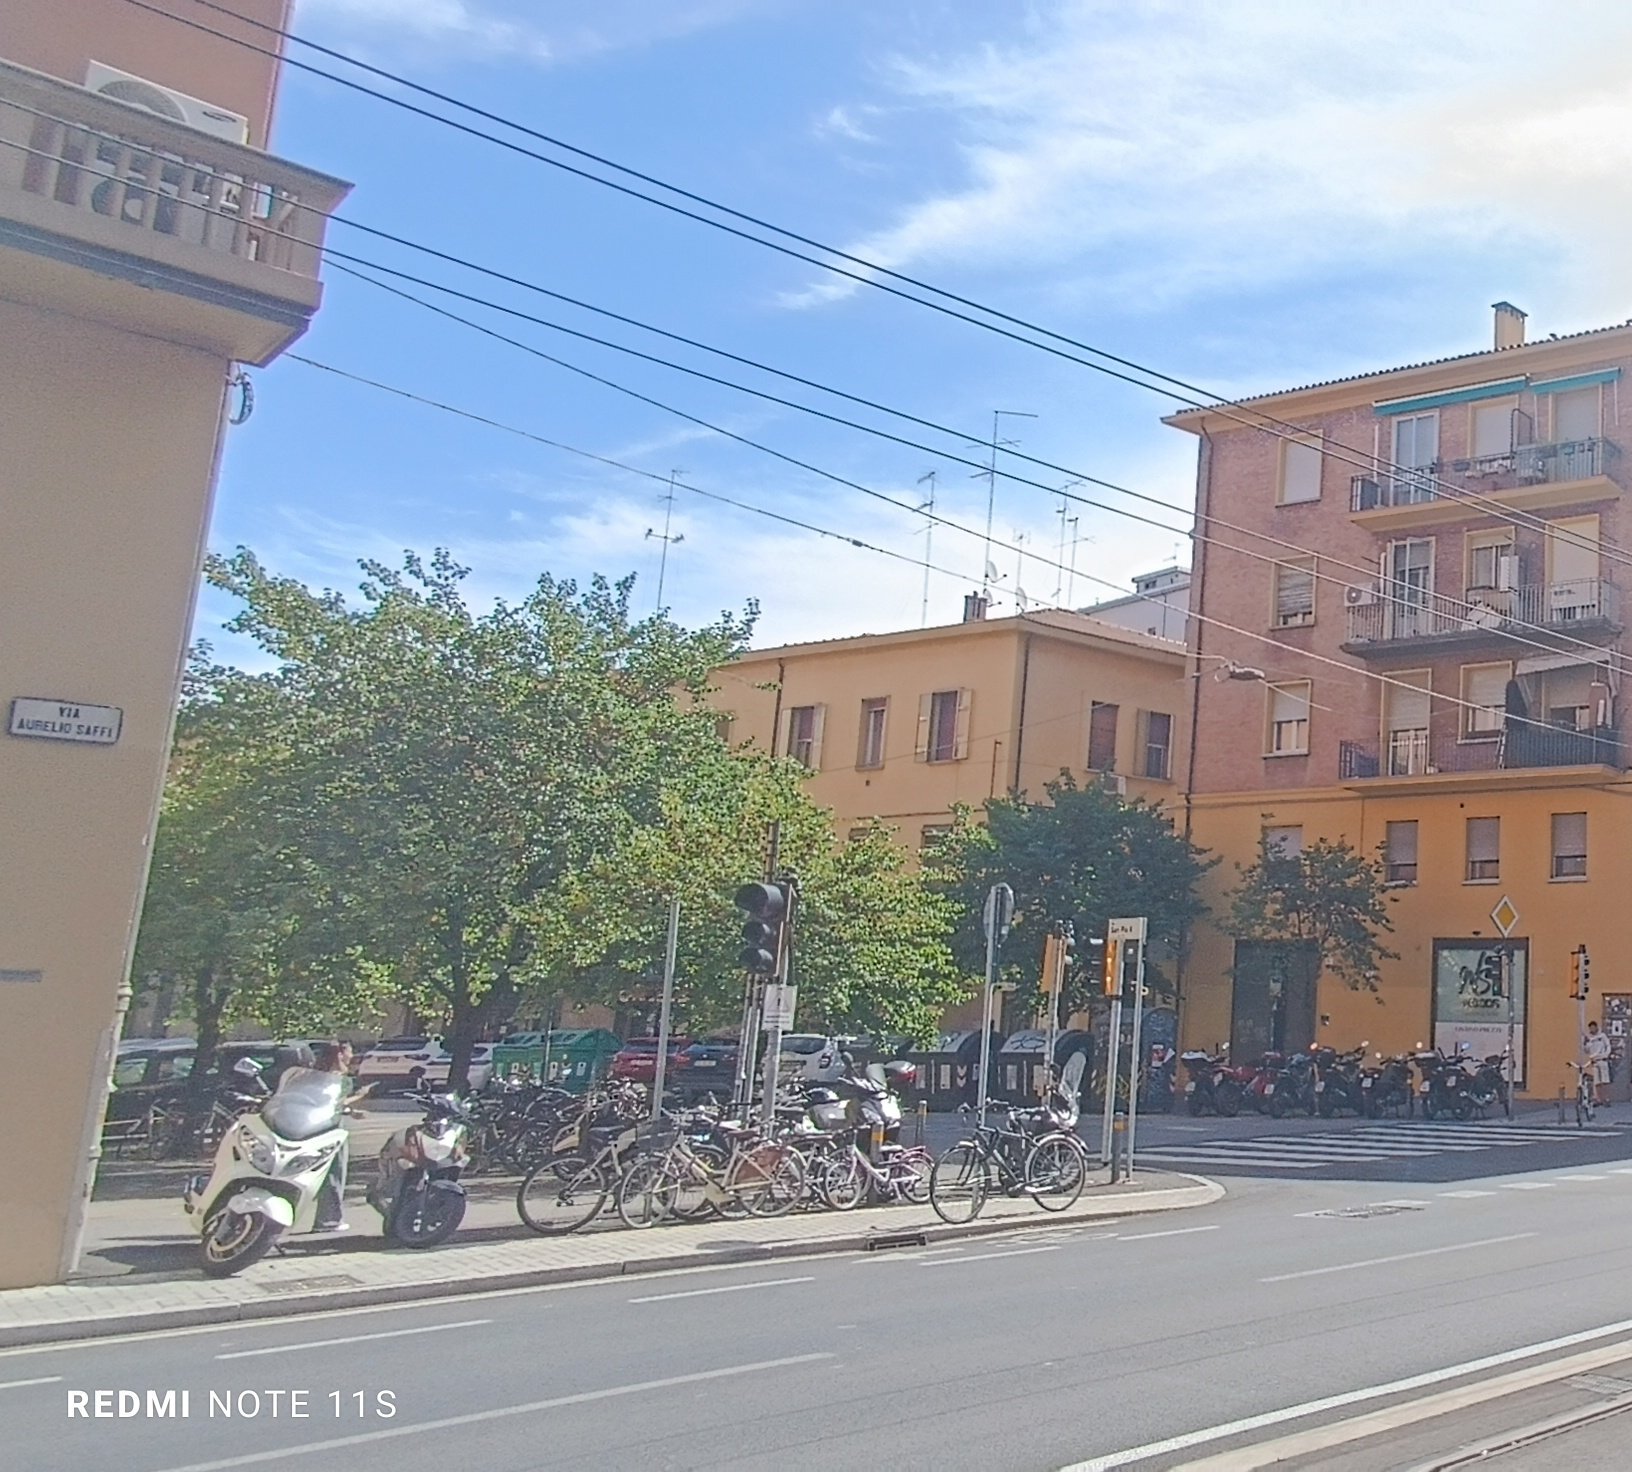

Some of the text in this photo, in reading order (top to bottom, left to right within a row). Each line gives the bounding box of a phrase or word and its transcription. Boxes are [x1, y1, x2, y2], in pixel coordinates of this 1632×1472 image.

[58, 706, 80, 719] VIA
[17, 718, 113, 738] AURELIO SAFFI
